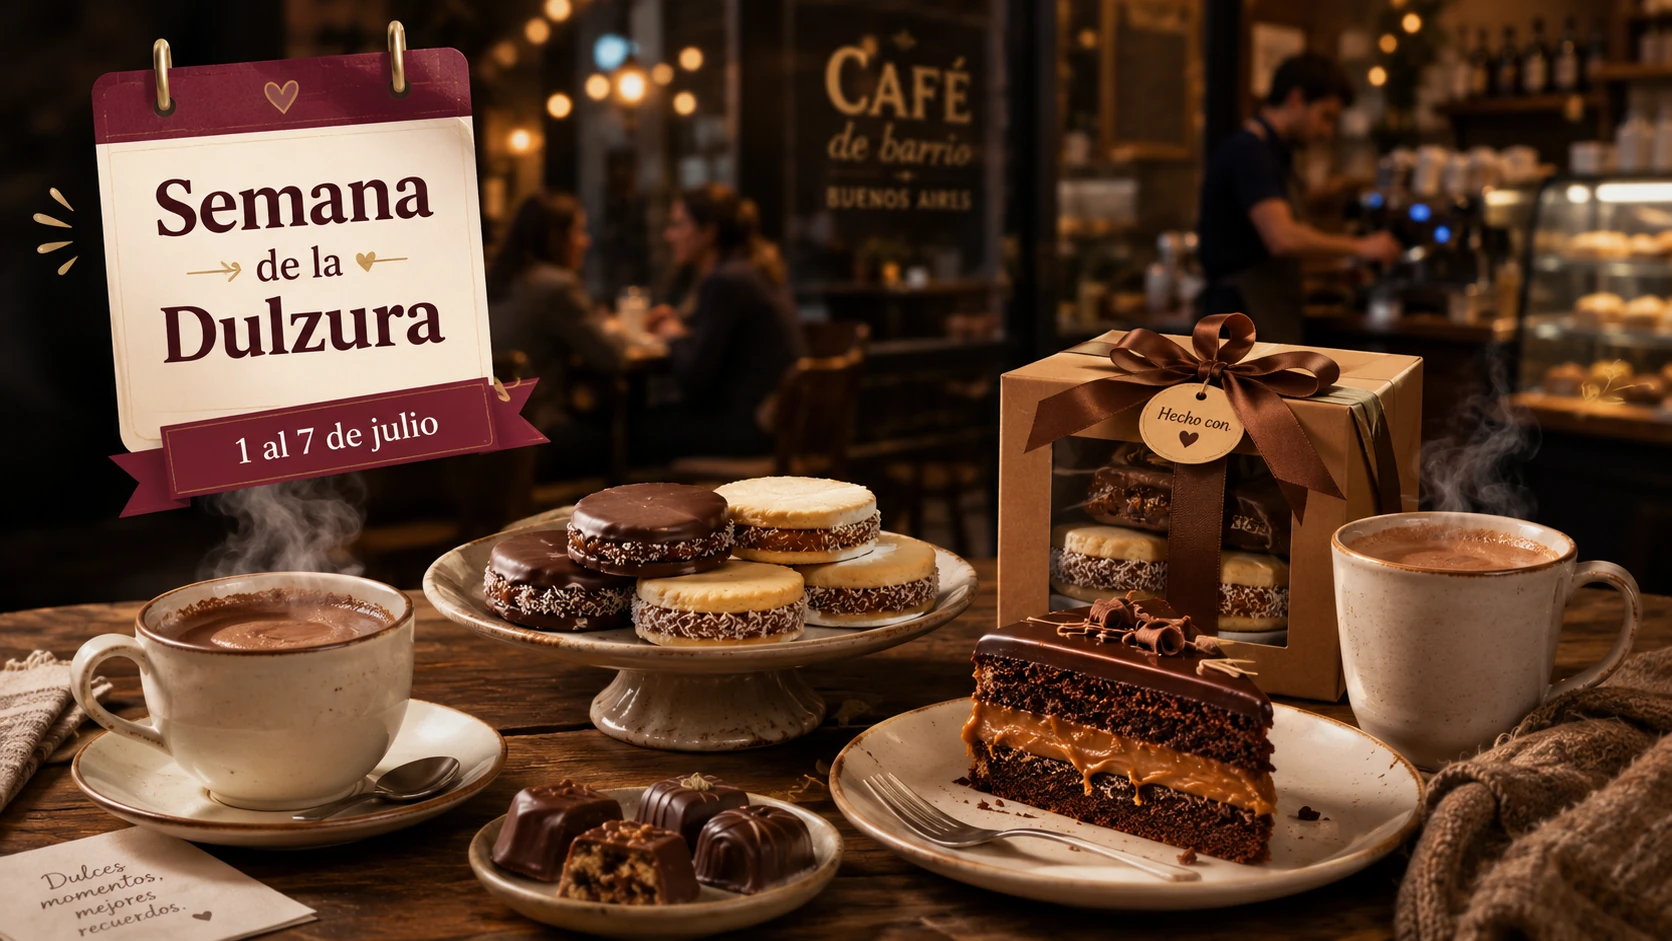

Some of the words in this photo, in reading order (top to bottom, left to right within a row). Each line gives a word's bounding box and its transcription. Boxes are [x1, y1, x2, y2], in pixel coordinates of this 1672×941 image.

[825, 45, 972, 124] CAFÉ
[828, 120, 869, 161] de
[878, 122, 972, 166] barrio
[826, 186, 910, 209] BUENOS
[917, 189, 971, 210] AIRES
[1157, 406, 1202, 426] Hecho
[41, 863, 126, 890] Dulces
[75, 891, 157, 920] mejores
[78, 903, 187, 937] recuerdos.
